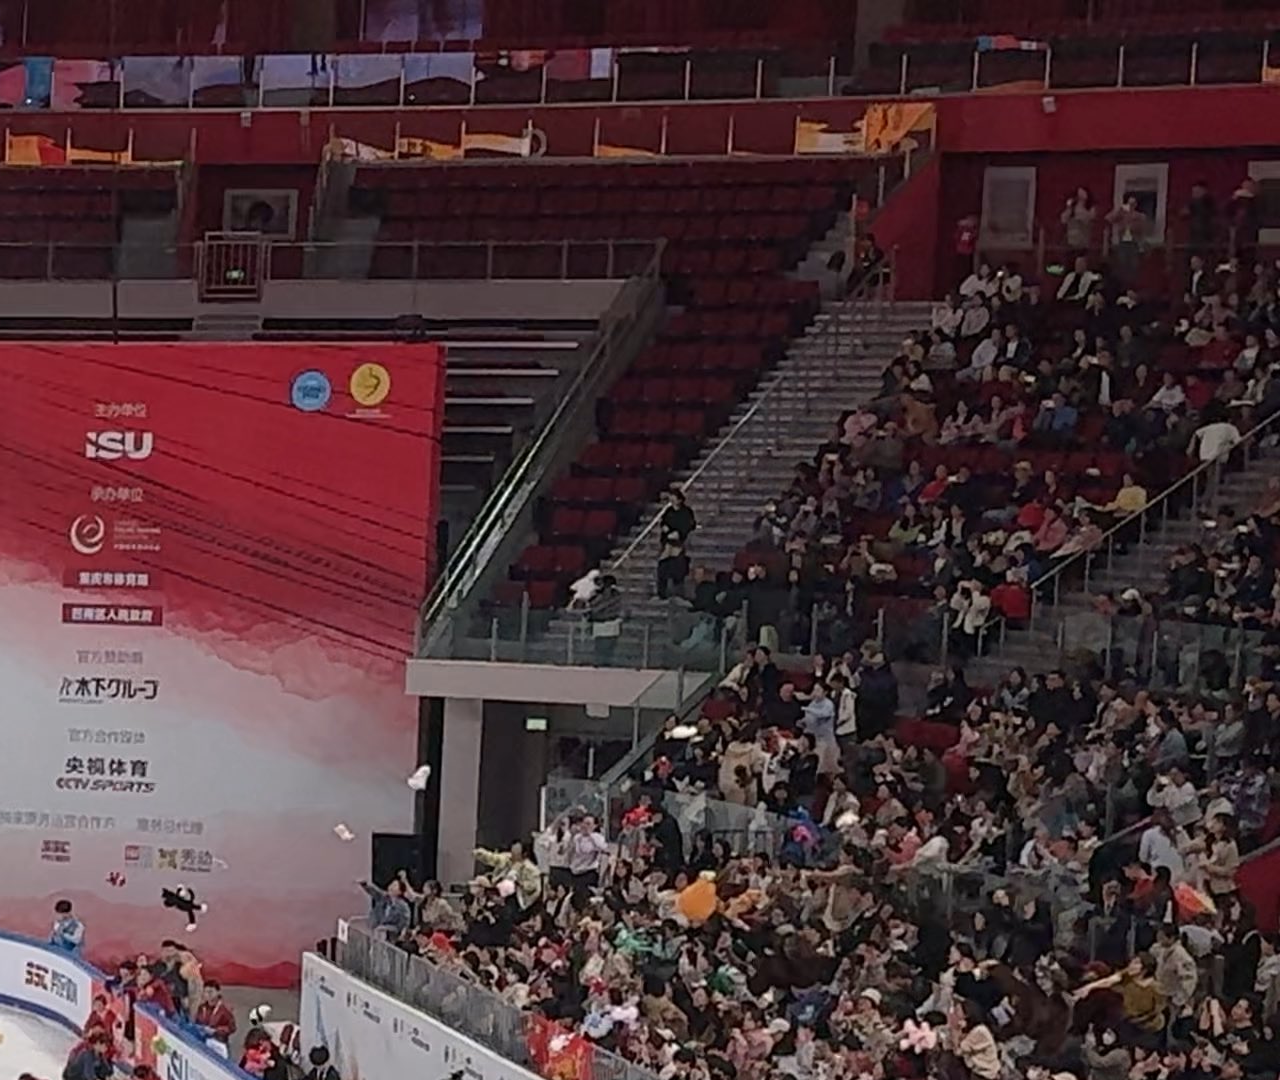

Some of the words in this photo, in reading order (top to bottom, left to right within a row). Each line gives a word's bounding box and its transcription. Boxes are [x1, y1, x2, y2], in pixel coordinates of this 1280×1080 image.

[85, 431, 154, 460] ISU
[65, 756, 149, 778] 央视体育
